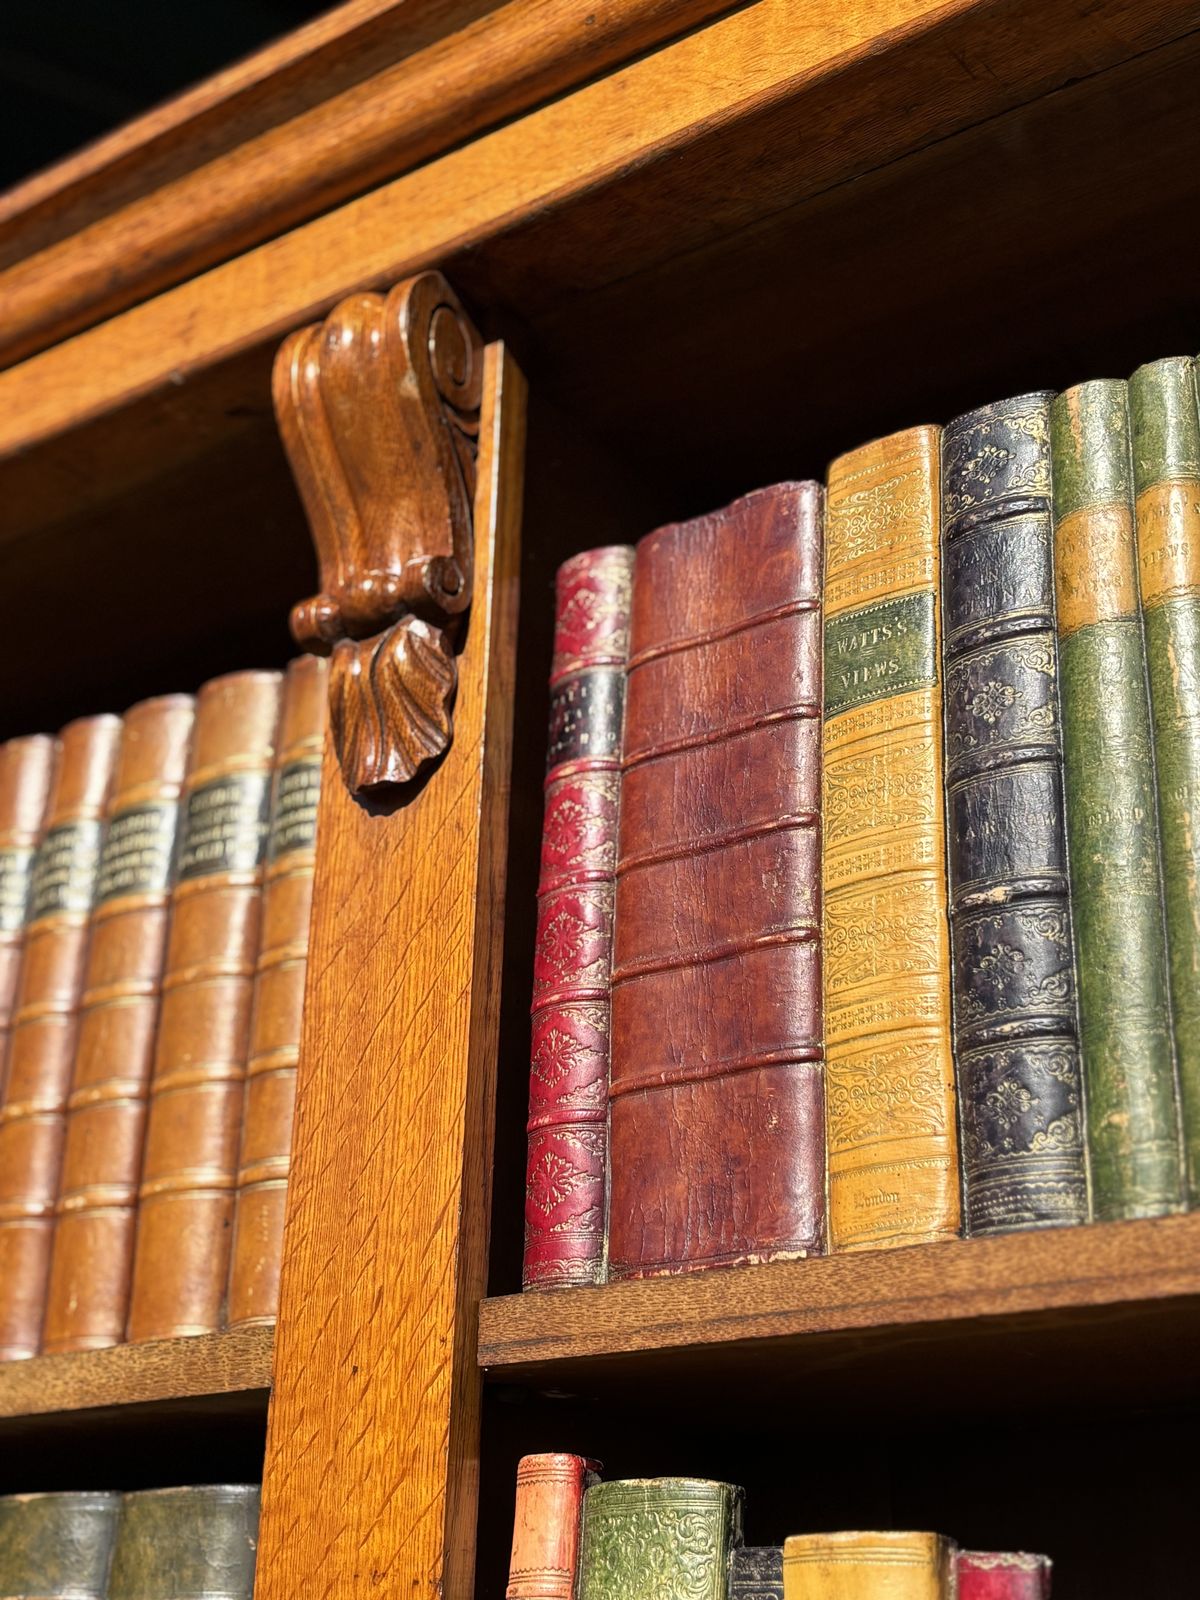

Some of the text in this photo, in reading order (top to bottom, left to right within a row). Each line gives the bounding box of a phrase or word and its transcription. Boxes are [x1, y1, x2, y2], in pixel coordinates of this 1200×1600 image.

[836, 616, 908, 655] WATTS'S
[840, 657, 900, 689] VIEWS
[854, 1188, 900, 1208] London
